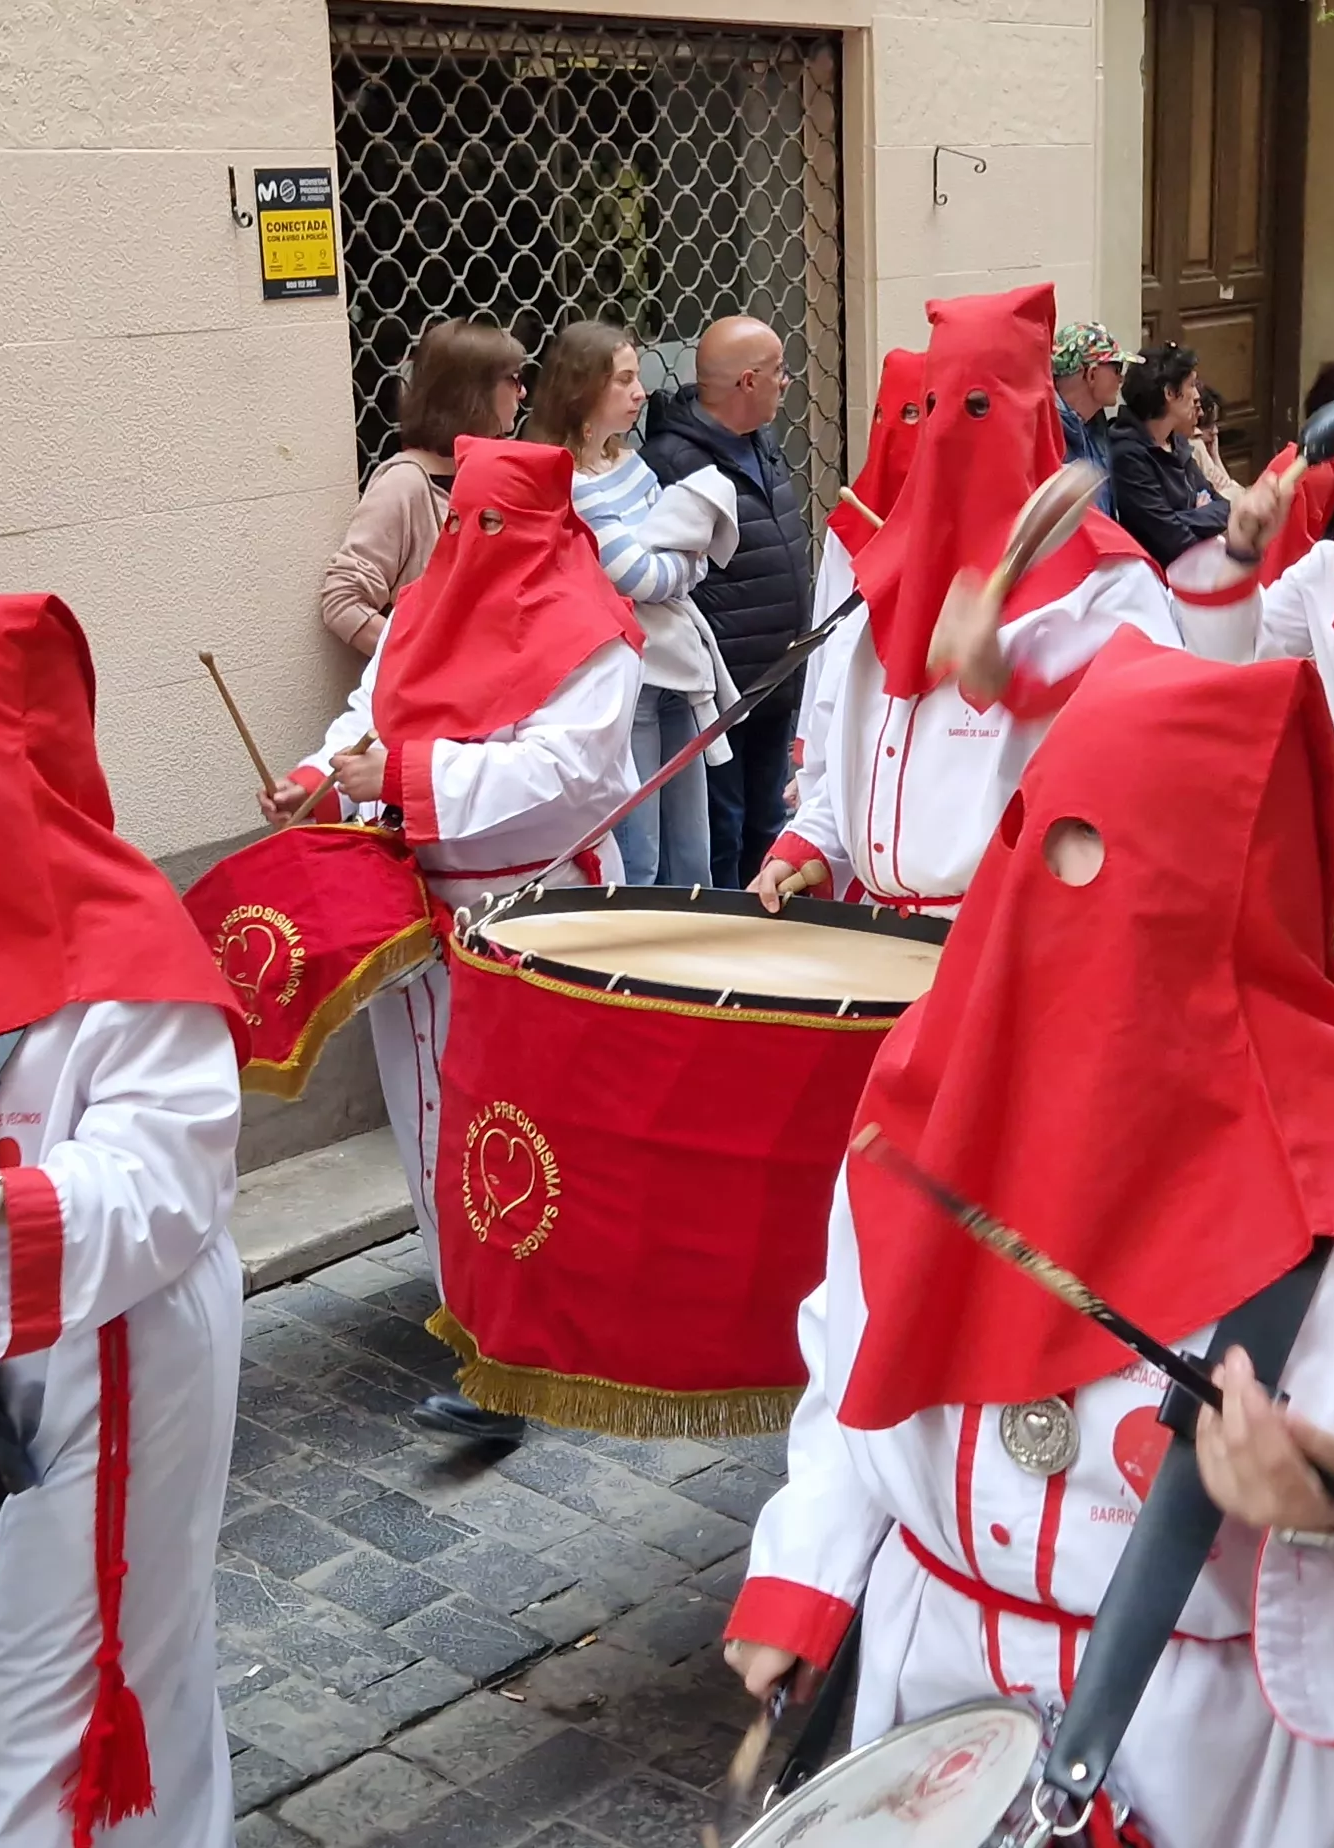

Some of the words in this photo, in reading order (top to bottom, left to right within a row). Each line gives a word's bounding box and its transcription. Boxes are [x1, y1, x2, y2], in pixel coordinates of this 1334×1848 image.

[266, 220, 328, 233] CONECTADA
[274, 947, 306, 1008] SANGRE
[475, 1105, 494, 1129] LA
[492, 1100, 562, 1199] PRECIOSISIMA
